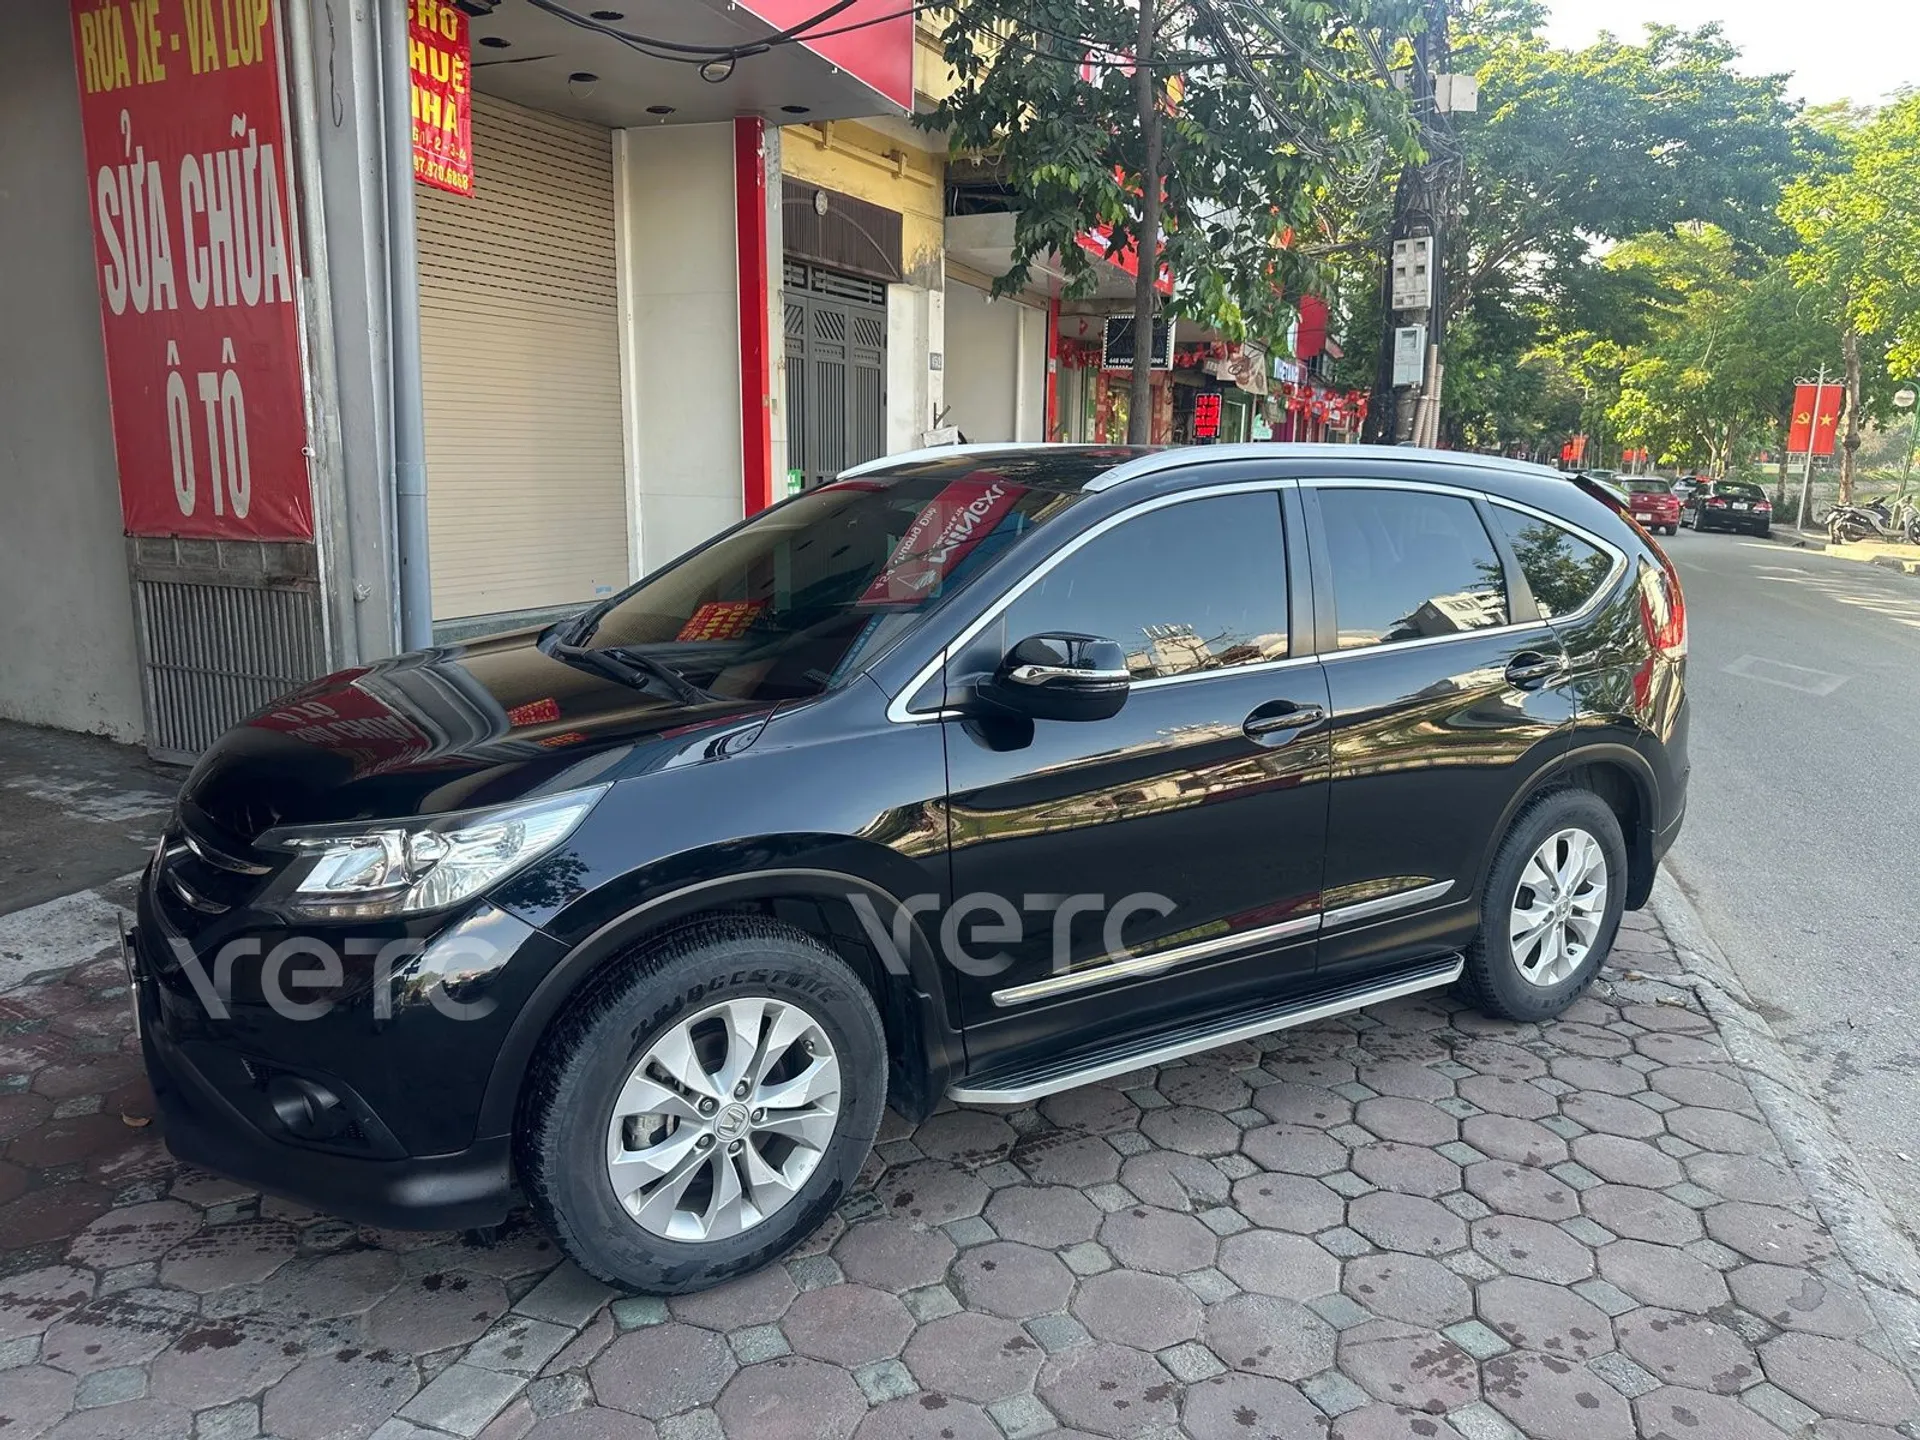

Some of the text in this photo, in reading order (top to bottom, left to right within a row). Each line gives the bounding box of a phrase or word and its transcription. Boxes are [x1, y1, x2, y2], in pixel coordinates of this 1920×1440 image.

[131, 0, 166, 85] XE
[408, 0, 458, 41] HO
[97, 109, 292, 316] SỬA CHỮA
[413, 154, 468, 191] 97.970.6868
[166, 337, 251, 519] Ô TÔ
